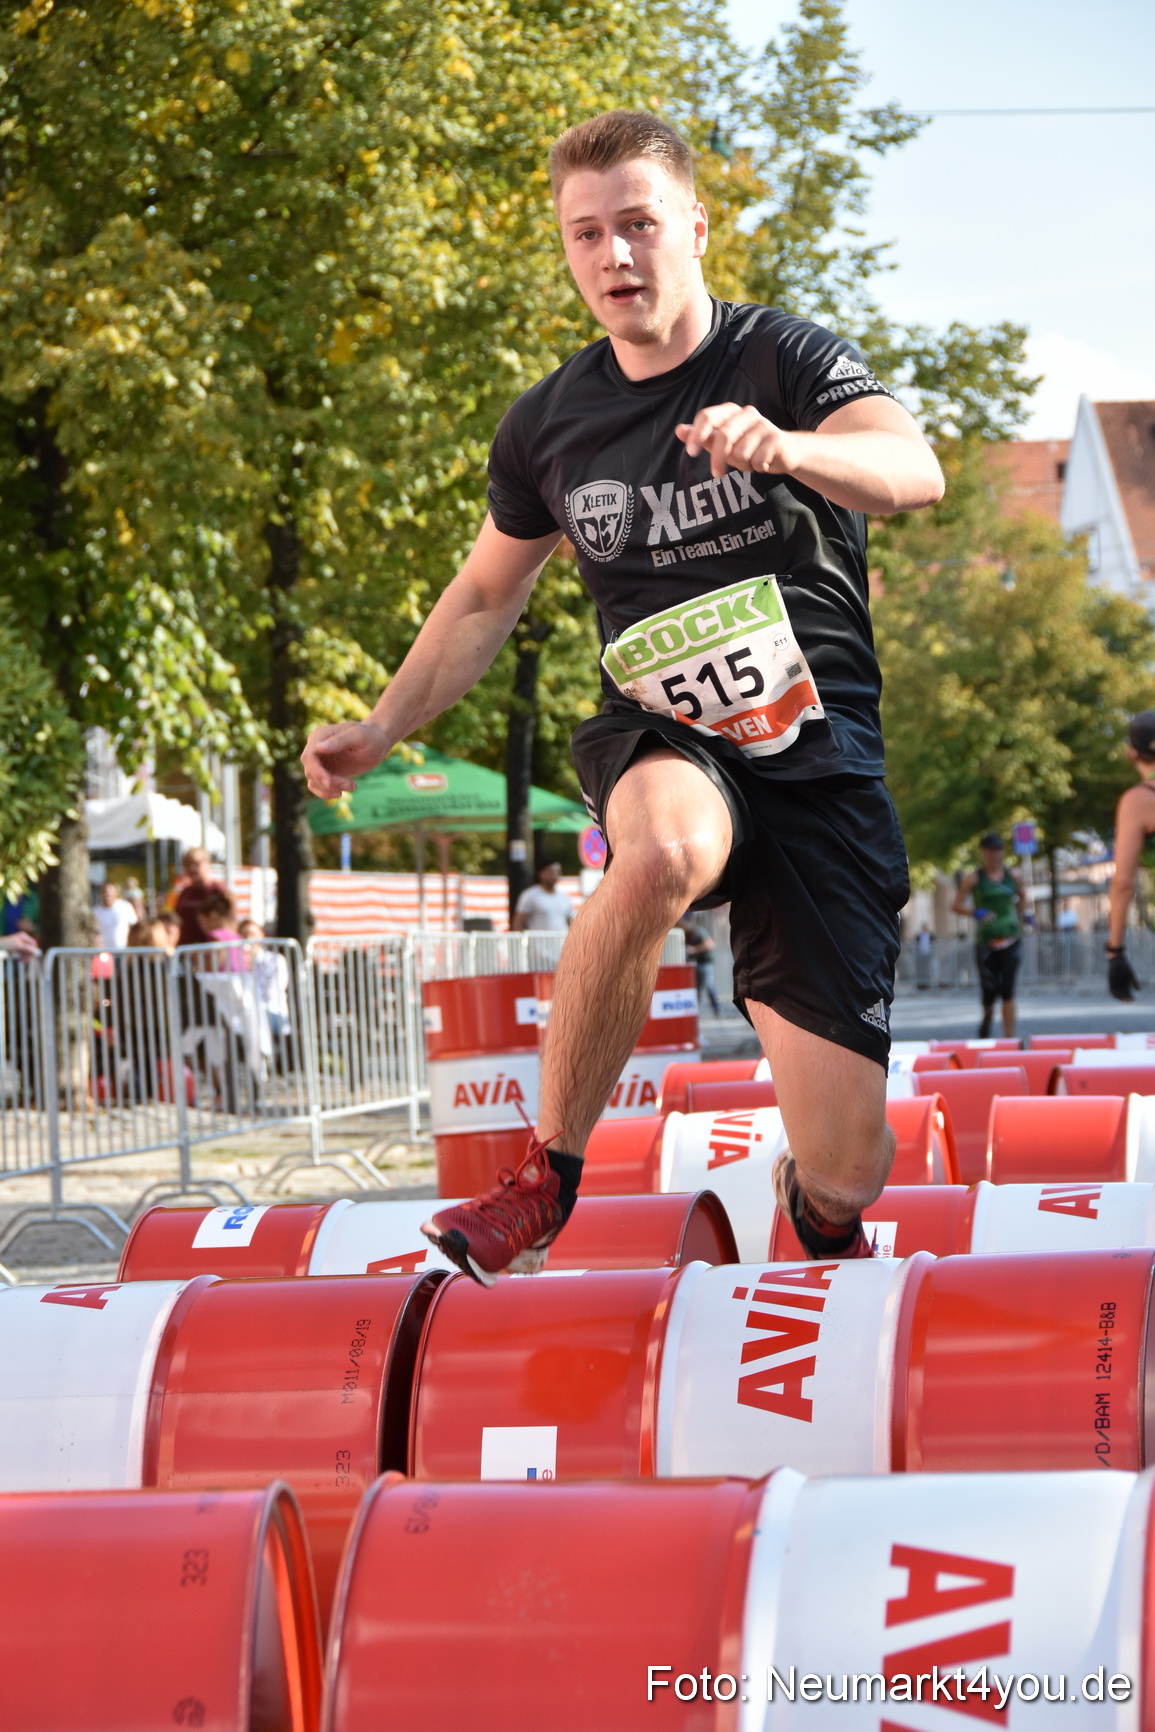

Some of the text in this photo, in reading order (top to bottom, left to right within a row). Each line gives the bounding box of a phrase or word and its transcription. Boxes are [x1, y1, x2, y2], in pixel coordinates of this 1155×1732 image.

[582, 492, 617, 513] XLETIX
[640, 468, 765, 546] XLETIX
[651, 549, 677, 568] Ein
[742, 519, 777, 545] Ziel!
[621, 595, 760, 669] BOCK
[774, 637, 788, 647] E11
[661, 646, 766, 721] 515
[718, 714, 773, 741] VEN
[860, 1012, 887, 1033] adida
[336, 1450, 350, 1488] 323
